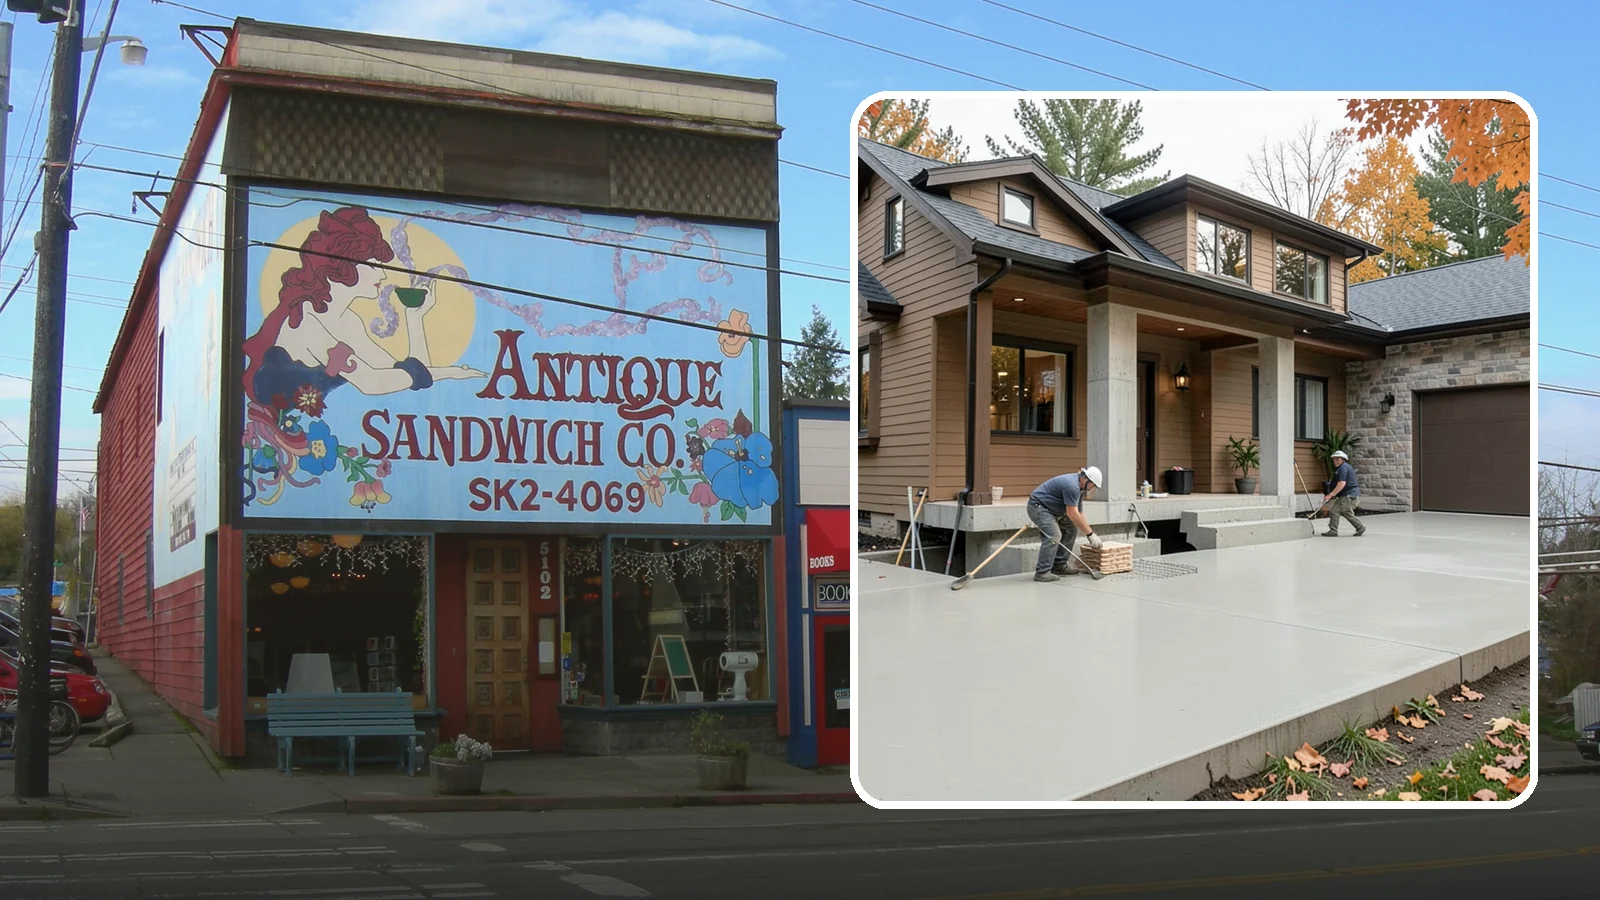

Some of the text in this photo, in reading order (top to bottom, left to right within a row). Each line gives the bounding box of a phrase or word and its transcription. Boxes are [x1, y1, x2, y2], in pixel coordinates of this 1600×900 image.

[475, 329, 723, 421] ANTIQUE
[361, 408, 685, 469] SANDWICH CO.
[468, 477, 645, 513] SK2-4069
[540, 542, 551, 599] 5102
[809, 555, 835, 569] BOOKS
